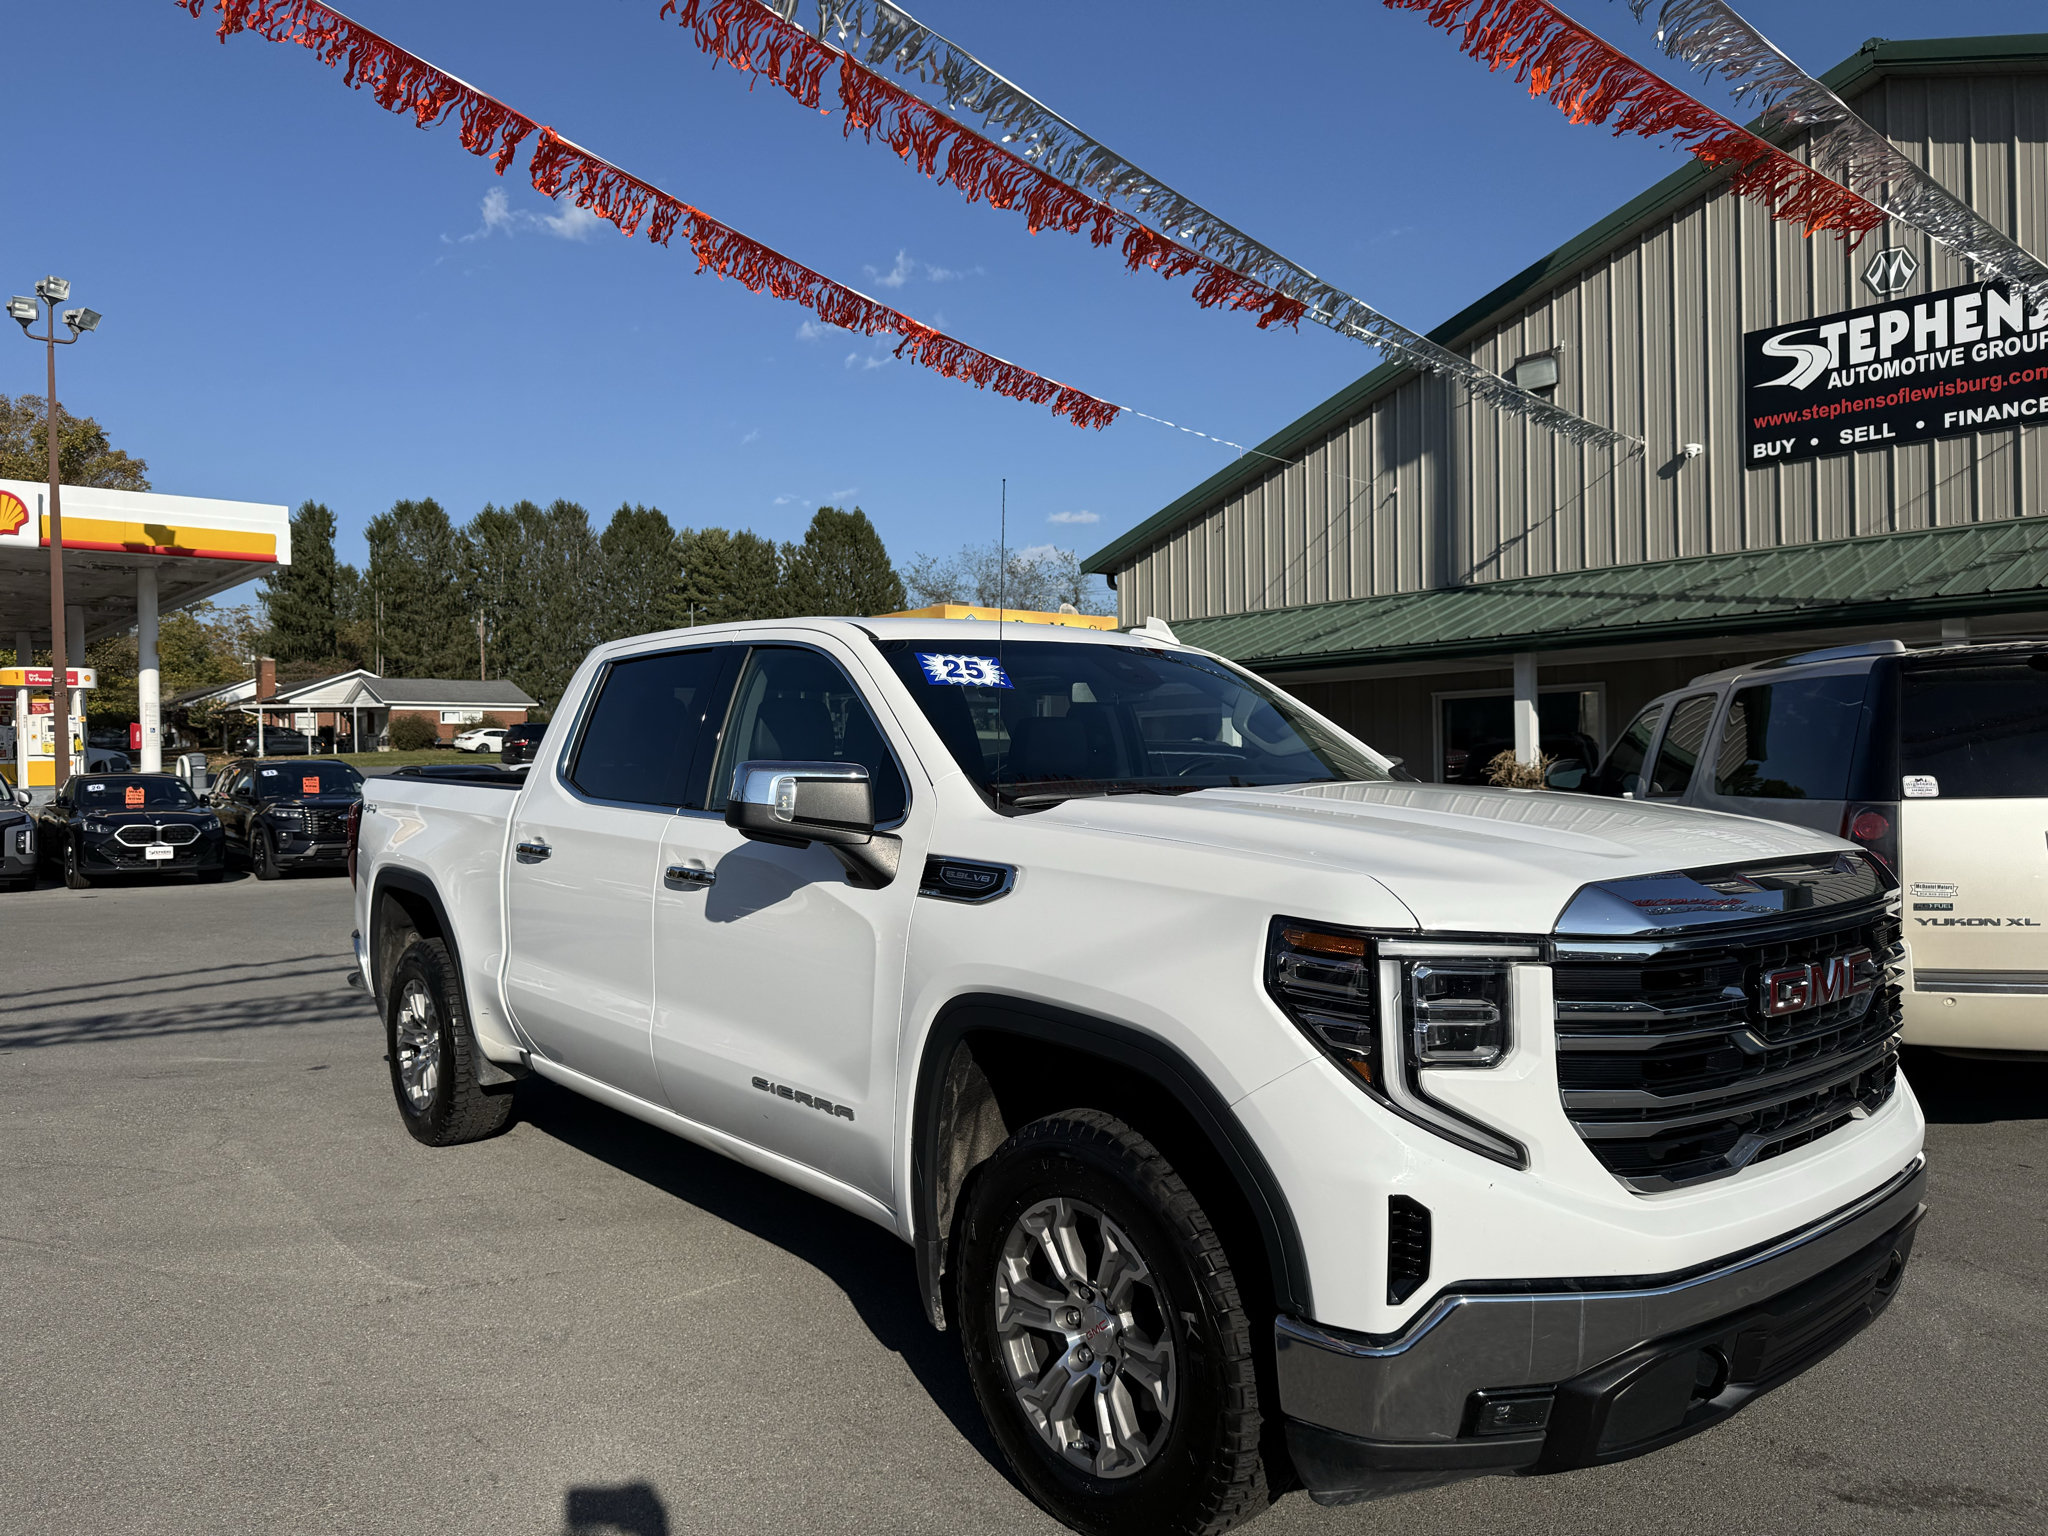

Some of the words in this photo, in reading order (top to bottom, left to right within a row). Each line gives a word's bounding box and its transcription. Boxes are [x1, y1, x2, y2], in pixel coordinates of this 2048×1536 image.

[1827, 347, 1965, 390] AUTOMOTIVE
[1753, 366, 2048, 429] www.stephensoflewisburg.com
[1753, 438, 1796, 459] BUY
[1839, 422, 1896, 445] SELL
[1944, 397, 2048, 428] FINANCE
[942, 659, 984, 679] 25
[973, 872, 991, 882] V8
[1914, 917, 2001, 926] YUKON
[2005, 917, 2042, 926] XL
[1762, 946, 1873, 1018] GMC
[751, 1076, 855, 1122] SIERRA
[1085, 1319, 1109, 1341] GMC
